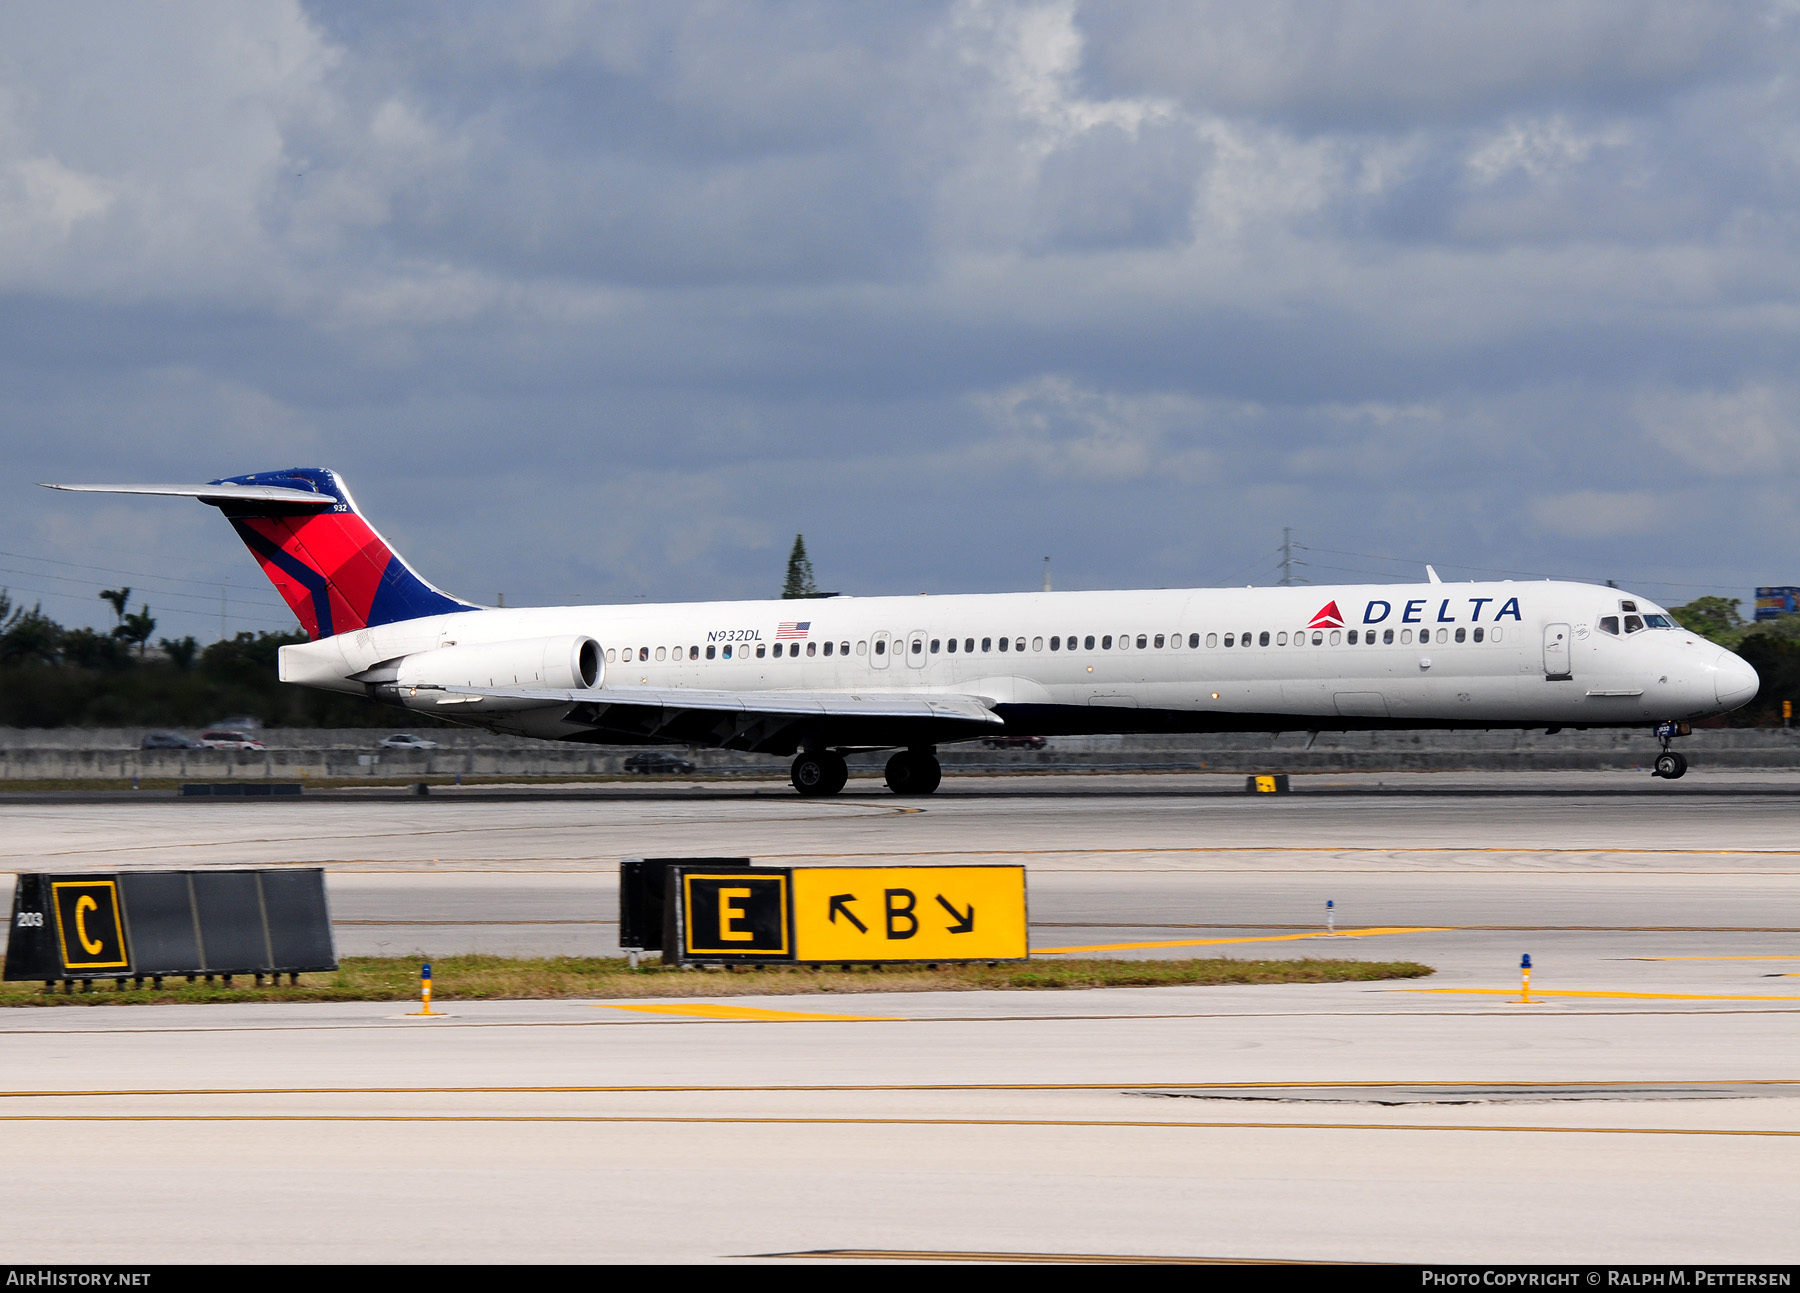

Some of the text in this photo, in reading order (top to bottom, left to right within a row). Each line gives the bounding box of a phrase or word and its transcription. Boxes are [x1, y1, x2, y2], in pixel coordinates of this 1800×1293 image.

[333, 504, 347, 512] 932
[1363, 597, 1522, 624] DELTA
[707, 629, 762, 642] N932DL
[17, 912, 44, 927] 203
[75, 895, 104, 955] C
[718, 887, 754, 941] E
[884, 888, 919, 940] B
